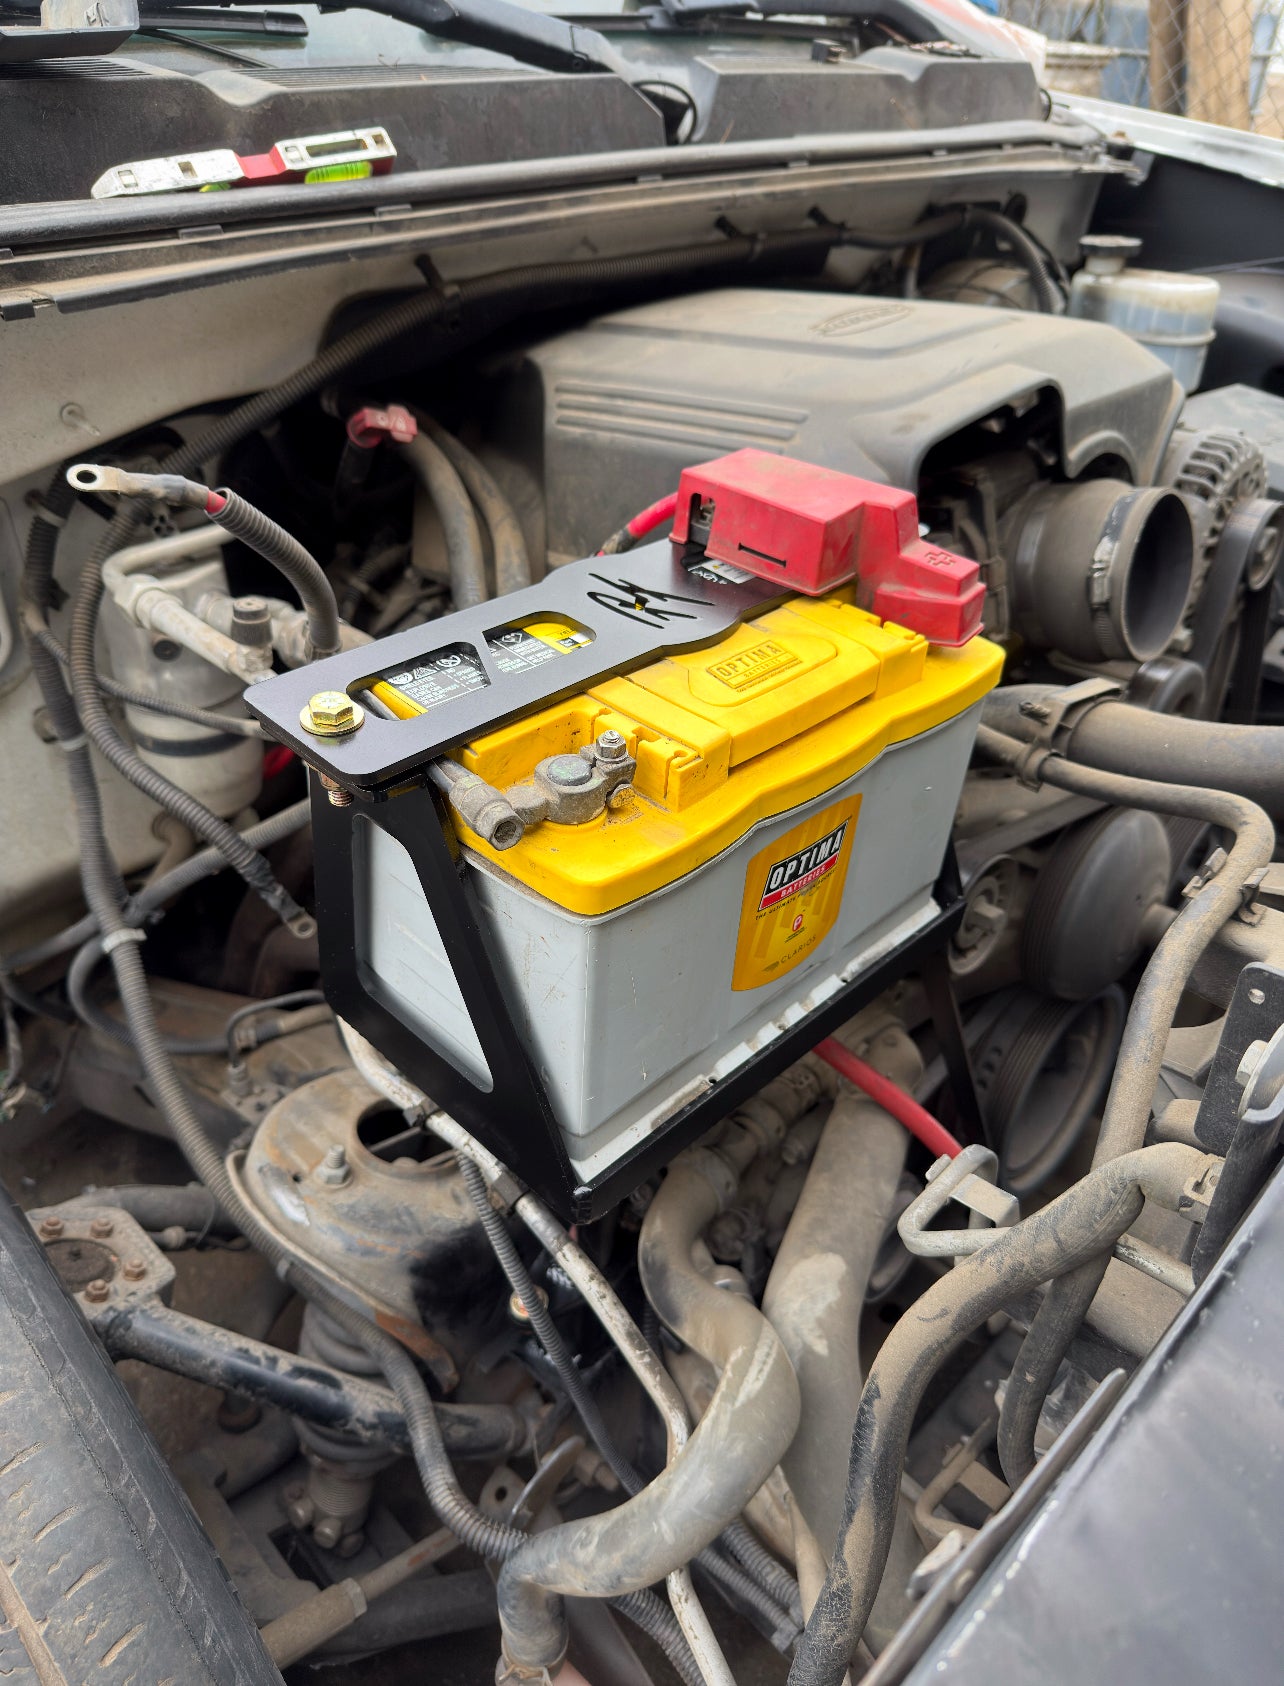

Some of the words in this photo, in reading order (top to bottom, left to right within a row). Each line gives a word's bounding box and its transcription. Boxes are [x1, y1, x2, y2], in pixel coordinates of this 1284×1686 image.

[717, 645, 782, 677] OPTIMA
[769, 829, 842, 890] OPTIMA
[781, 865, 826, 898] BATTERIES
[781, 934, 816, 963] CLARIOS
